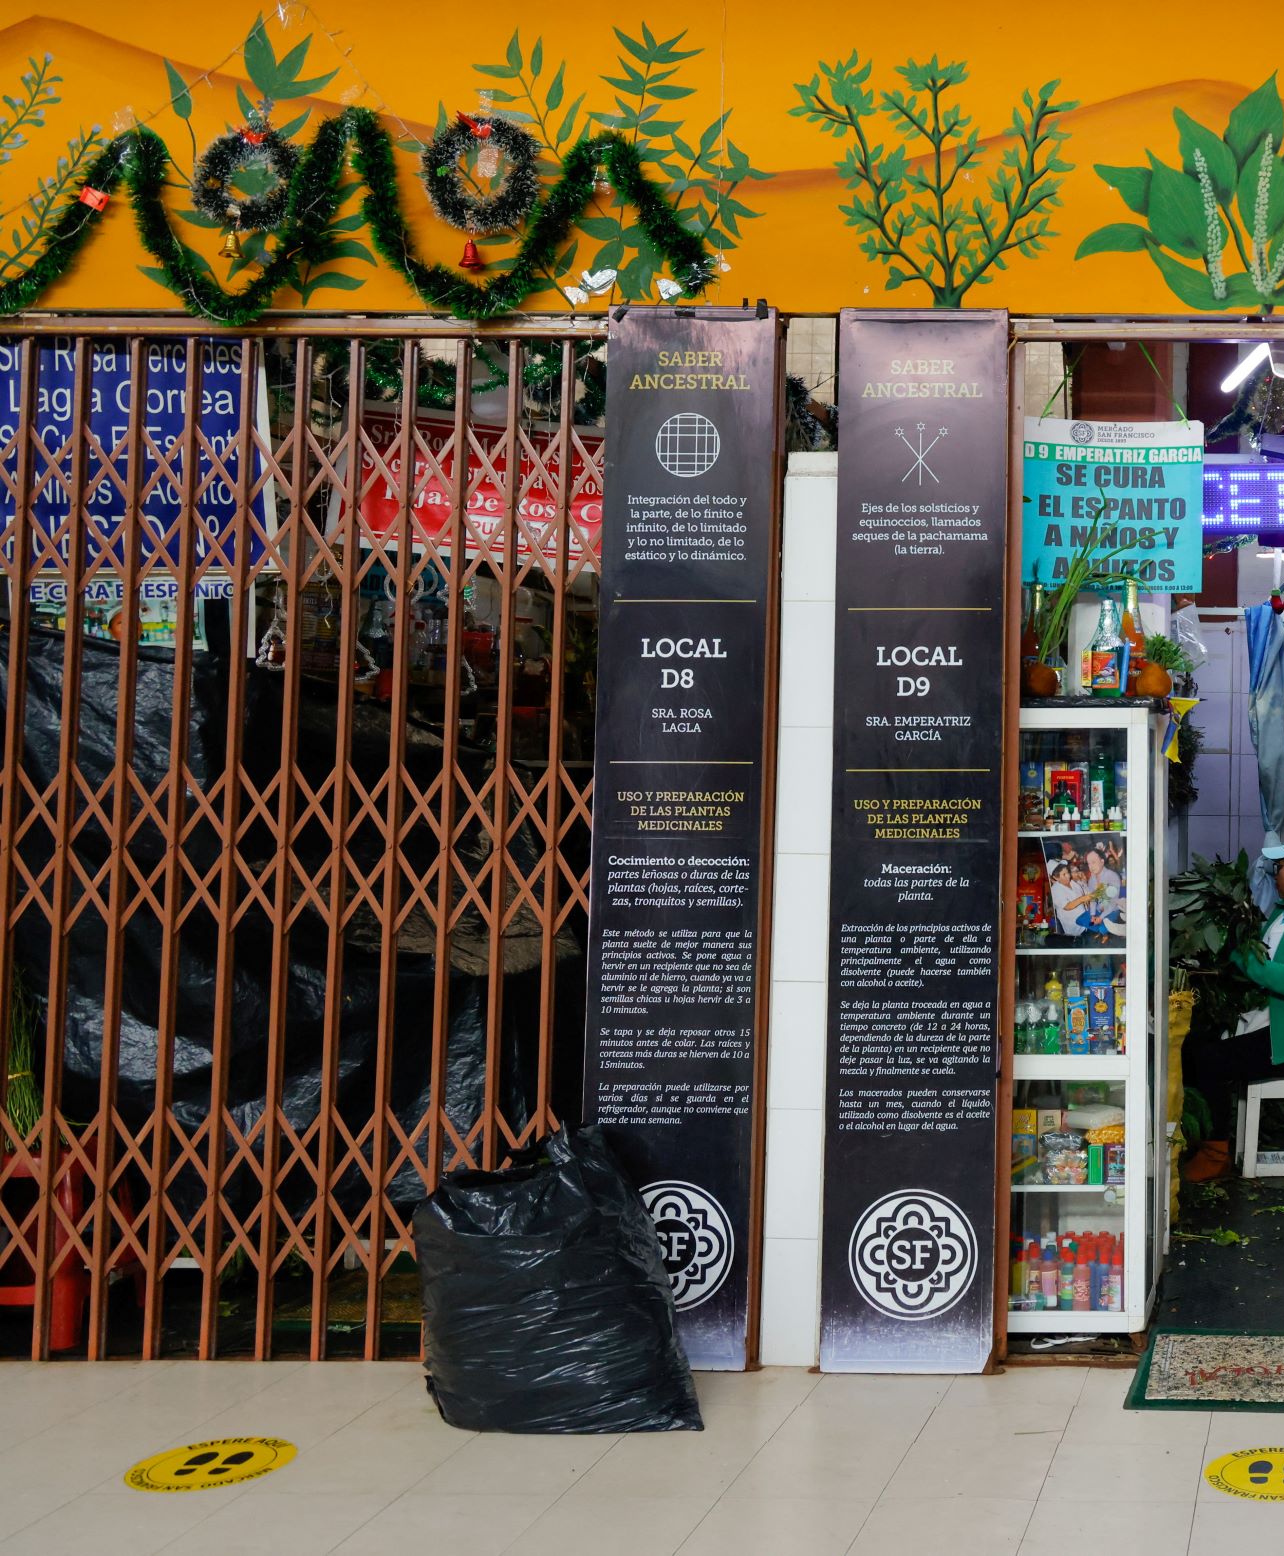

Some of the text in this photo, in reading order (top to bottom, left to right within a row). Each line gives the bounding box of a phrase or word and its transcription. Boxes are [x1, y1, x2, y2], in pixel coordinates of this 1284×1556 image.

[658, 350, 722, 367] SABER
[890, 359, 955, 375] SABER
[629, 373, 751, 390] ANCESTRAL
[862, 382, 983, 398] ANCESTRAL
[9, 379, 103, 421] Laga
[1024, 444, 1203, 463] D 9 EMPERATRIZ GARCIA
[1056, 463, 1165, 489] SE CURA
[627, 494, 748, 507] Integración del todo y
[1038, 494, 1187, 520] EL ESPANTO
[630, 508, 743, 521] la parte, de lo finito e
[861, 502, 980, 515] Ejes de los solsticios y
[859, 516, 982, 529] equinoccios, llamados
[1043, 522, 1179, 550] A NIÑOS Y
[144, 582, 235, 600] ESPNTO
[640, 637, 728, 659] LOCAL
[876, 645, 963, 667] LOCAL
[660, 668, 695, 689] D8
[896, 676, 931, 697] D9
[651, 708, 713, 719] SRA. ROSA
[662, 722, 702, 733] LAGLA
[865, 716, 971, 727] SRA. EMPERATRIZ
[894, 728, 942, 741] GARCÍA
[616, 789, 745, 802] USO Y PREPARACIÓN
[853, 798, 982, 810] USO Y PREPARACIÓN
[630, 805, 731, 817] DE LAS PLANTAS
[867, 813, 968, 824] DE LAS PLANTAS
[637, 820, 723, 831] MEDICINALES
[874, 828, 960, 839] MEDICINALES
[608, 855, 750, 867] Cocimiento o decocción:
[607, 869, 750, 881] partes leñosas o duras de las
[880, 863, 952, 874] Maceración:
[863, 876, 970, 890] todas las partes de la
[897, 890, 934, 903] planta.
[601, 928, 753, 940] Este método se utiliza para que la
[840, 923, 992, 934] Extracción de los principios activos de
[856, 978, 887, 987] alcohol
[894, 978, 925, 987] aceite).
[891, 1239, 932, 1270] SF
